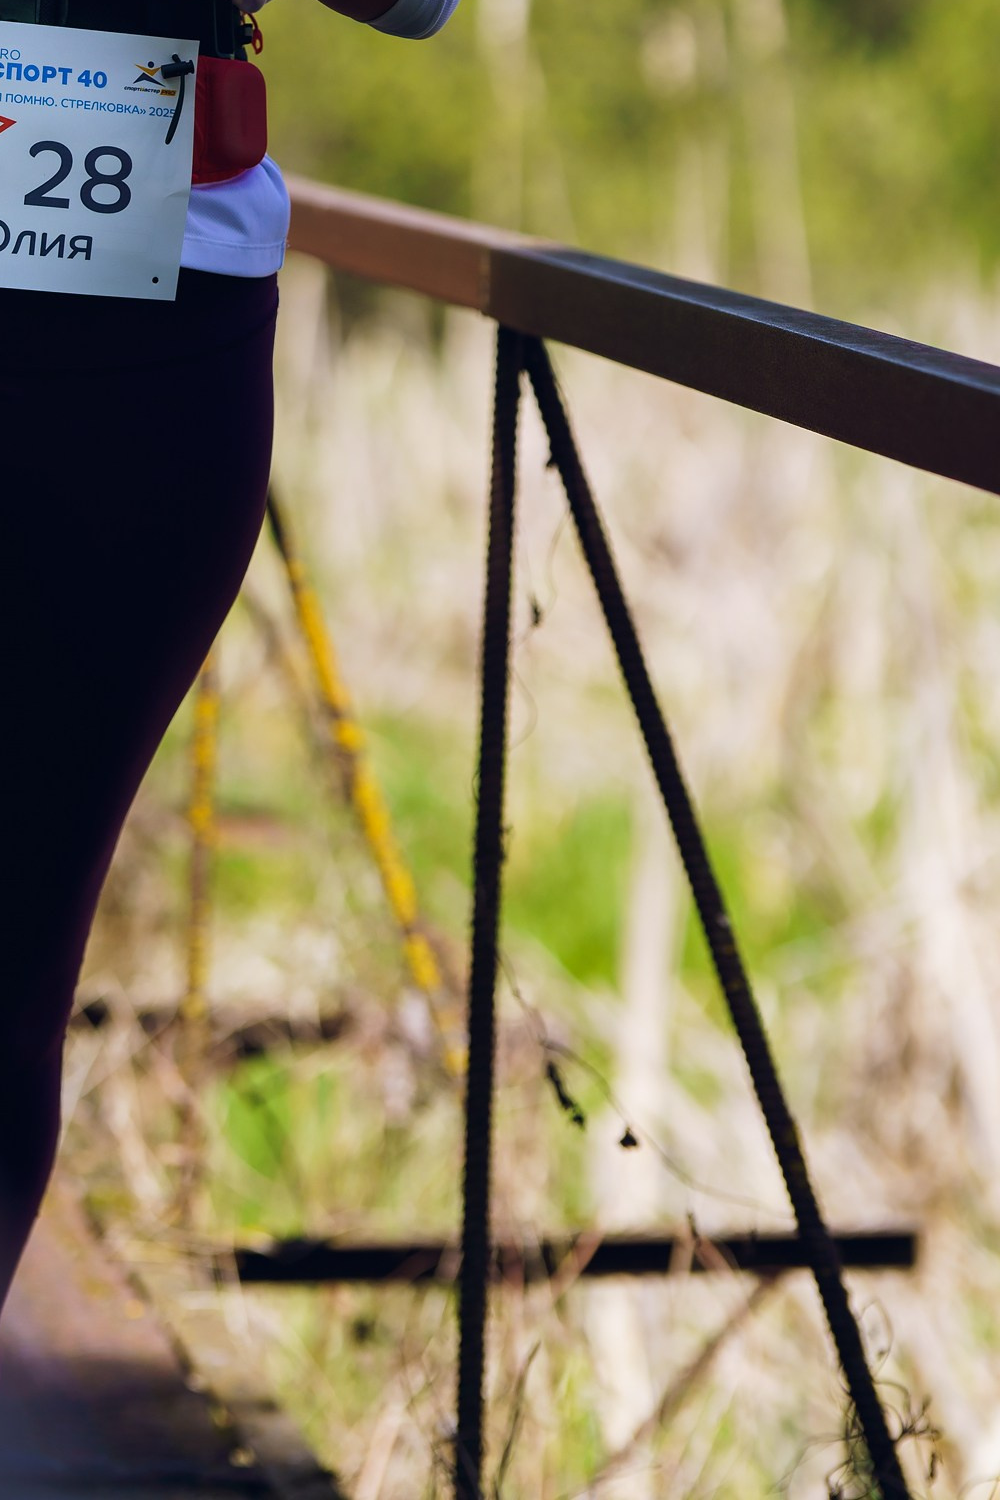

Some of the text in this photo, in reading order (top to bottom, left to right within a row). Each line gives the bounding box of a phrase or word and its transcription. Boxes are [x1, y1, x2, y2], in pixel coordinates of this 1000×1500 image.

[77, 70, 108, 89] 40
[6, 95, 58, 108] ПОМНЮ.
[61, 98, 146, 115] СТРЕЛКОВКА»
[24, 140, 133, 214] 28
